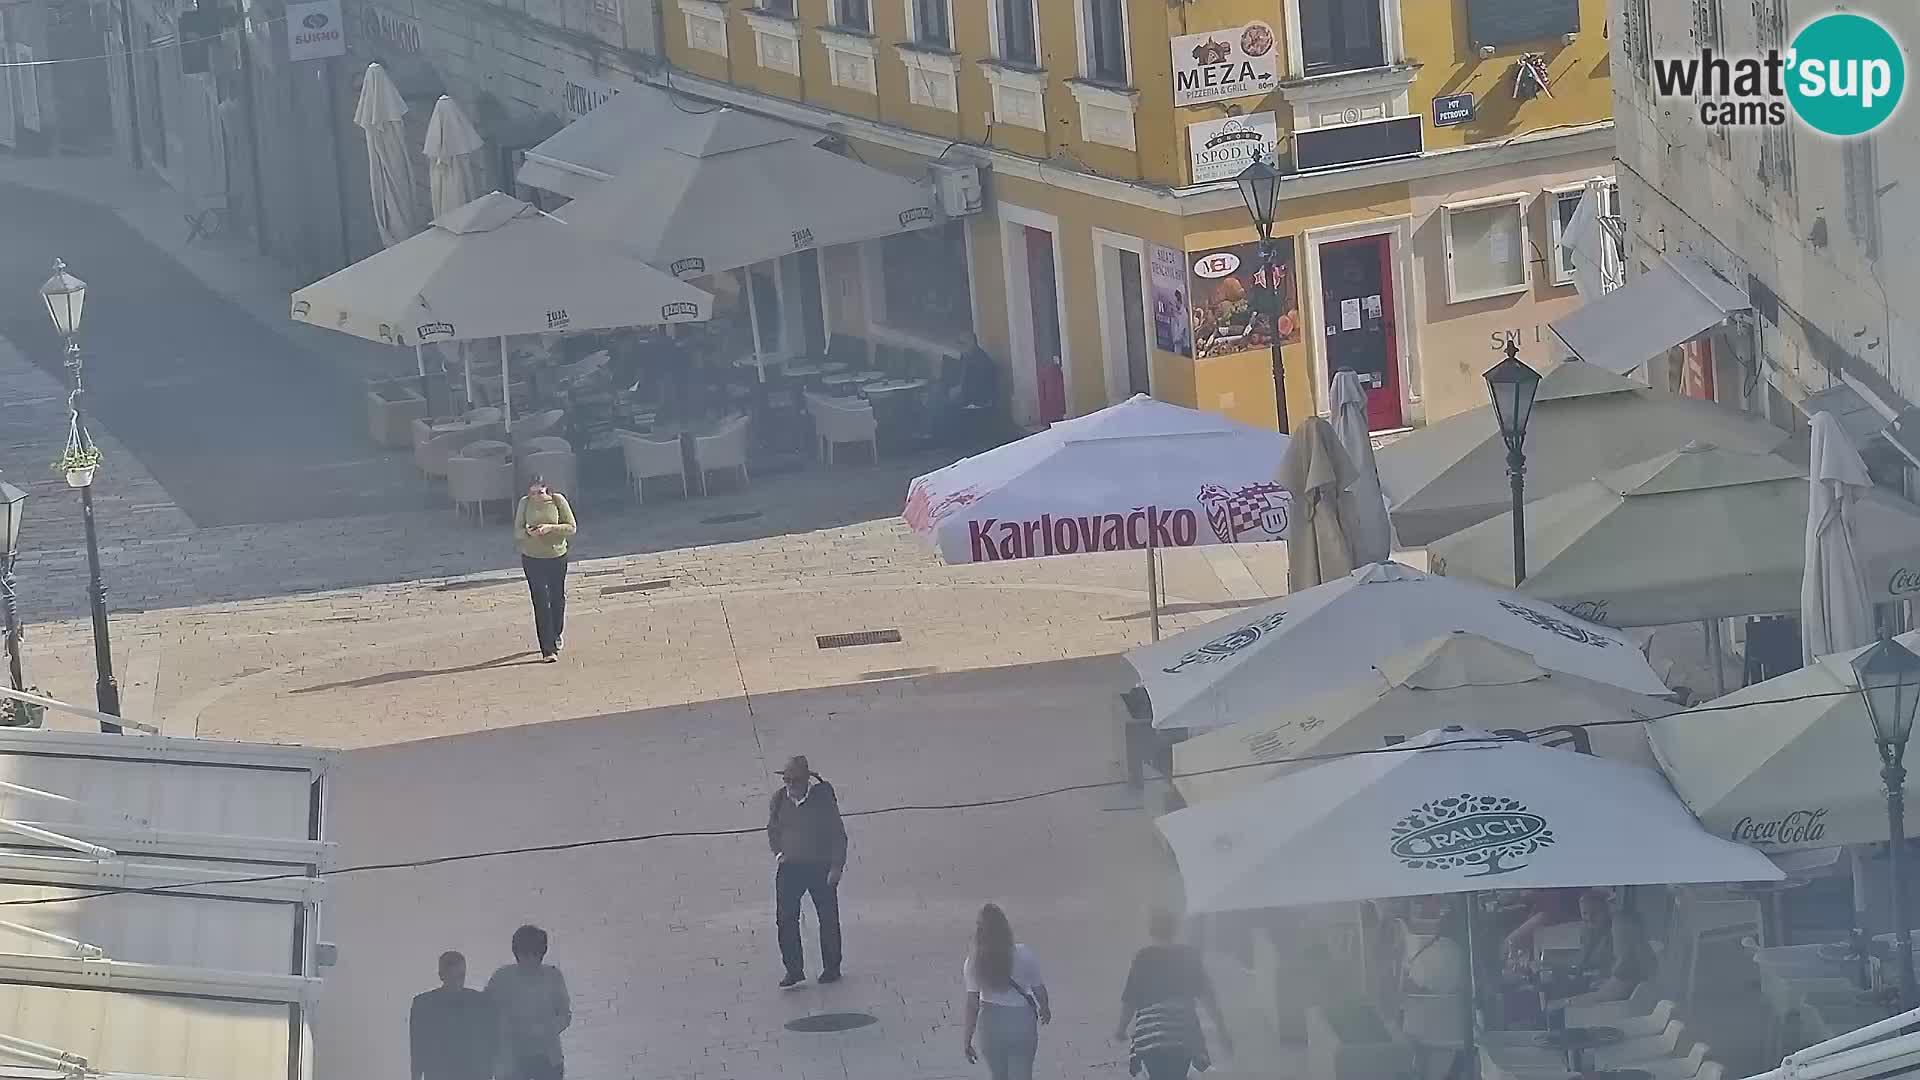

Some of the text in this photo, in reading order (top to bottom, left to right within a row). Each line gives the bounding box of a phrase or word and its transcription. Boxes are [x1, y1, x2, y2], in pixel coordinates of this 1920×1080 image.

[1177, 60, 1257, 92] MEZA
[1186, 87, 1220, 99] PIZZERIA
[1227, 83, 1248, 93] GRILL
[1195, 147, 1242, 165] ISPOD
[967, 505, 1199, 563] Karlovačko
[1429, 817, 1529, 849] RAUCH
[1731, 808, 1830, 845] Coca-Cola
